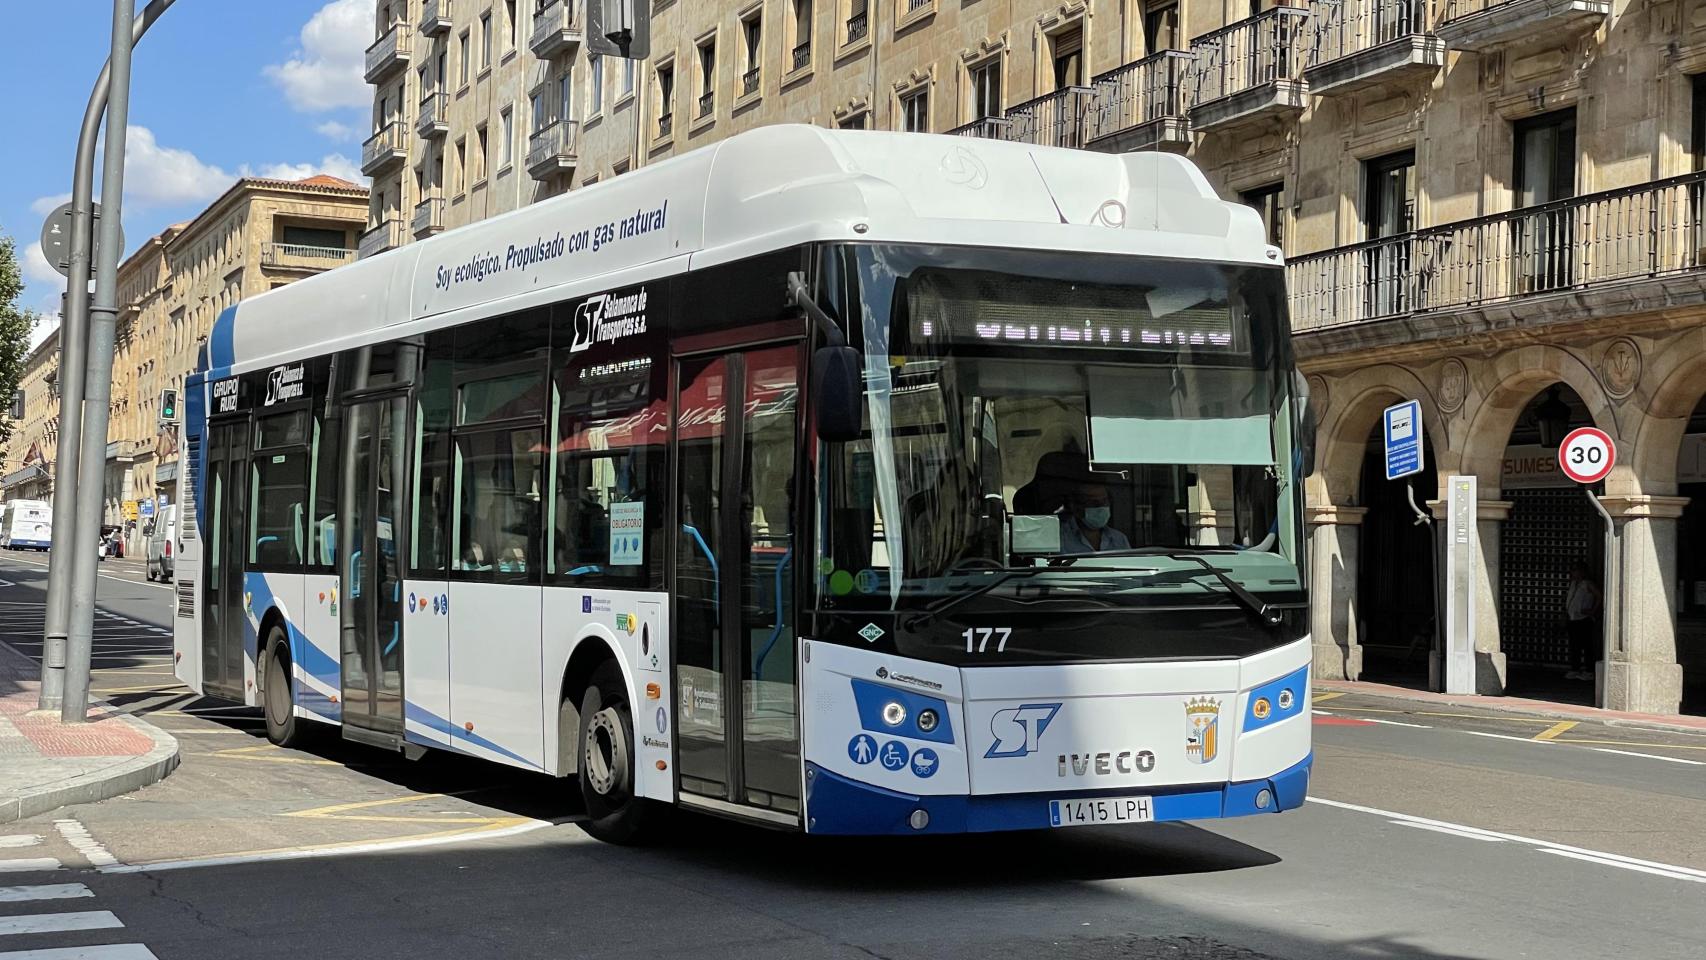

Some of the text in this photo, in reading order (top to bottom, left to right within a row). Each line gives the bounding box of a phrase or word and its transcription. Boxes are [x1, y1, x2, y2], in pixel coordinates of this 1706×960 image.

[436, 199, 668, 292] Soy ecológico. Propulsado con gas natural
[604, 286, 647, 320] Salamanca de
[597, 314, 647, 345] Transportes s.a.
[213, 378, 239, 398] GRUPO
[220, 394, 237, 413] RUIZ
[1571, 446, 1602, 464] 30
[863, 628, 880, 637] GNC
[961, 627, 1013, 653] 177
[984, 702, 1063, 759] ST
[1058, 749, 1156, 777] IVECO
[1065, 799, 1149, 823] 1415 LPH
